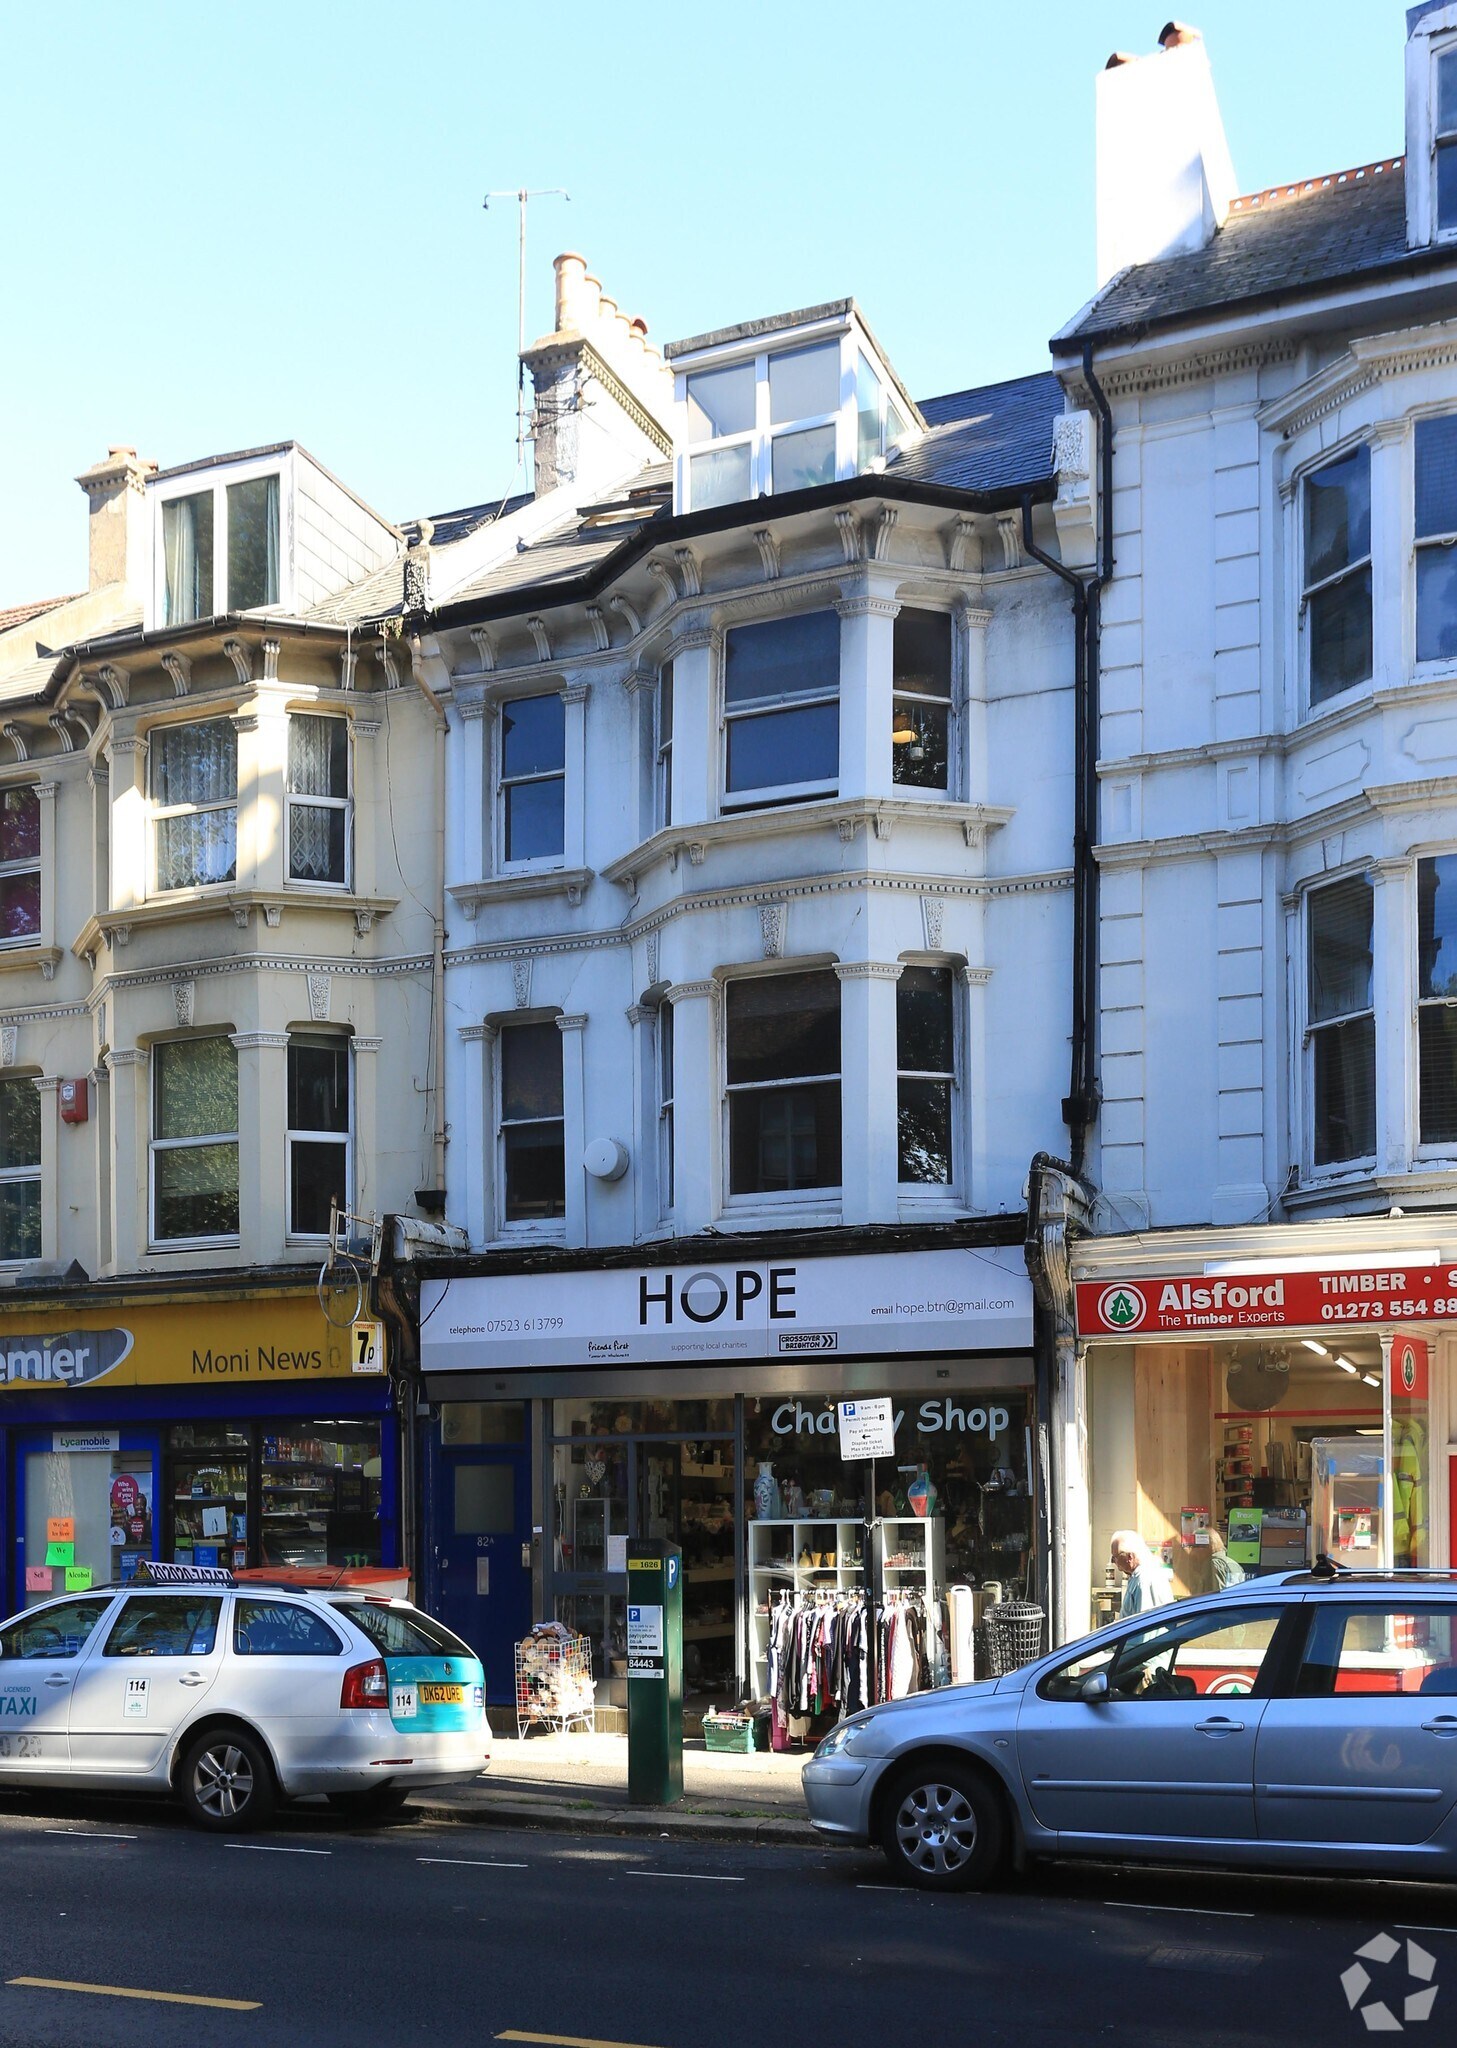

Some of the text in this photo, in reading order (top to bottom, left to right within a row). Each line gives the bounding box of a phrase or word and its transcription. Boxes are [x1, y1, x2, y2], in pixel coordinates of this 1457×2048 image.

[1318, 1272, 1407, 1294] TIMBER
[639, 1267, 797, 1325] HOPE
[1157, 1279, 1285, 1312] Alsford
[870, 1298, 1015, 1316] email hope.btn@gmail.com
[1320, 1301, 1384, 1320] 01273
[1389, 1299, 1429, 1316] 554
[1158, 1310, 1286, 1326] The Timber Experts
[449, 1317, 565, 1336] telephone 07523 613799
[671, 1341, 748, 1352] supporting local charities
[781, 1334, 821, 1343] CROSSOVER
[785, 1341, 820, 1349] BRIGHTON
[192, 1346, 322, 1375] Moni News
[916, 1397, 1010, 1441] Shop
[60, 1436, 111, 1448] Lycamobile
[56, 1546, 66, 1554] We
[628, 1659, 654, 1668] 84443
[129, 1680, 146, 1691] 114
[423, 1686, 445, 1701] DK62
[0, 1696, 37, 1715] TAXI
[396, 1694, 412, 1707] 114
